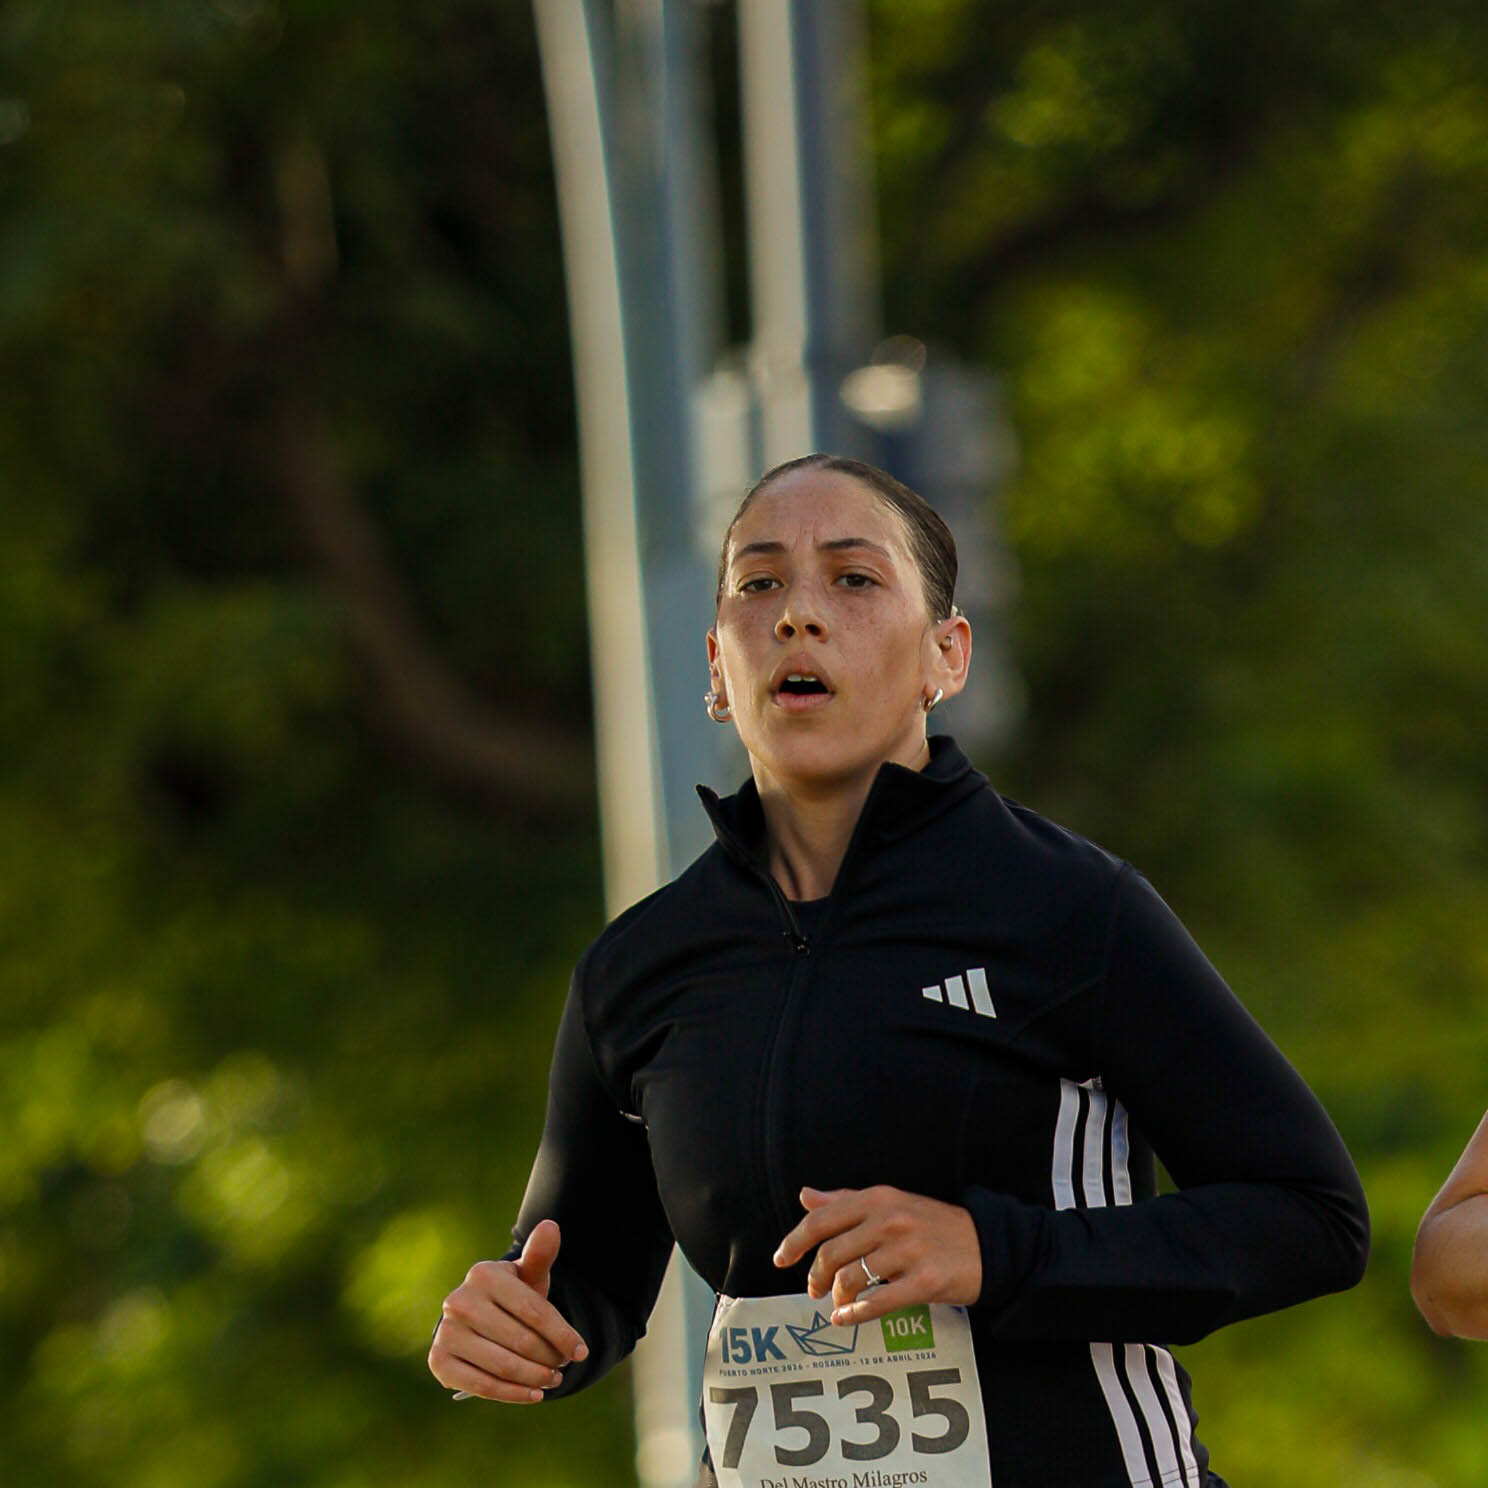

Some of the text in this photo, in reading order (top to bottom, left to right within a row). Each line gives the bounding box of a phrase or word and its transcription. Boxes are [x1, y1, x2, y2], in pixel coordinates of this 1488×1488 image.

[886, 1314, 927, 1337] 10K
[719, 1326, 787, 1365] 15K
[719, 1369, 747, 1377] PUERTO
[750, 1366, 779, 1375] NORTE
[812, 1359, 850, 1368] ROSARIO
[872, 1356, 883, 1364] DE
[887, 1353, 912, 1363] ABRIL
[709, 1367, 970, 1469] 7535
[852, 1470, 928, 1488] Milagros
